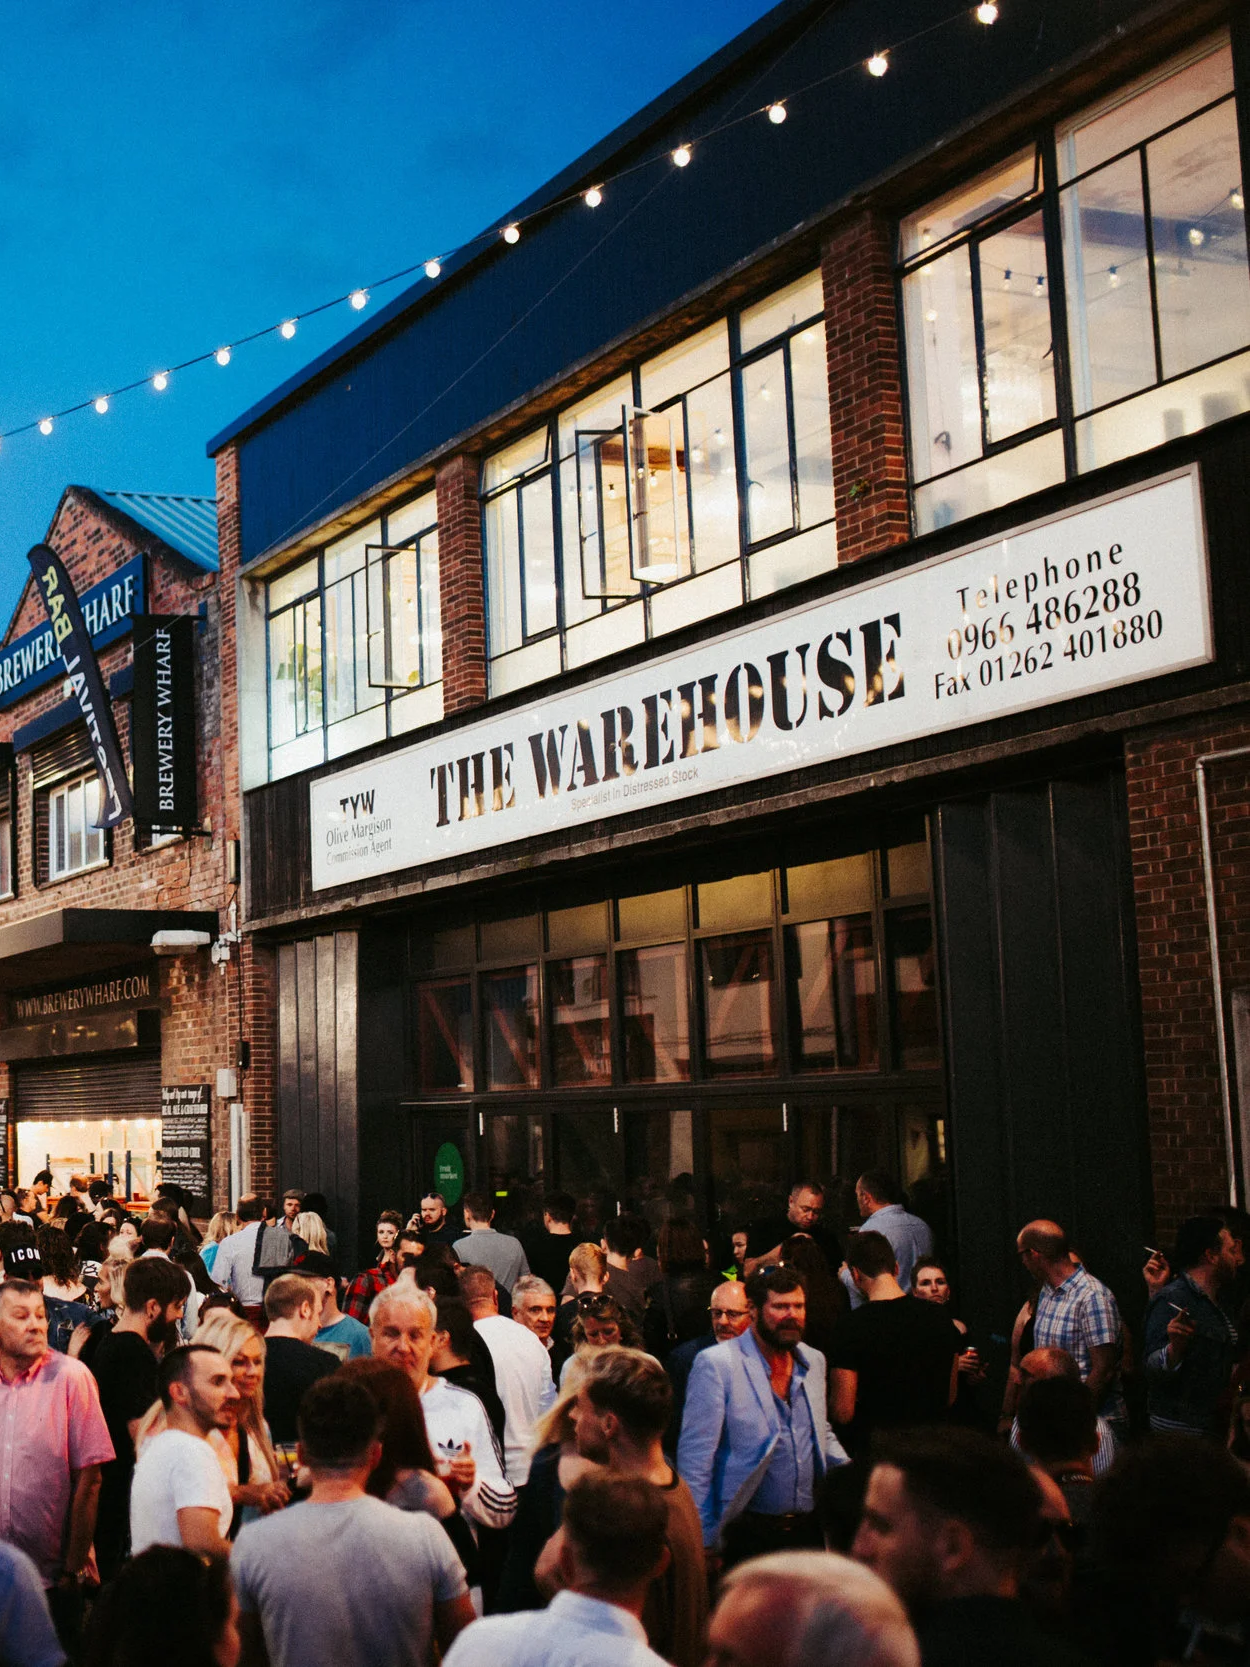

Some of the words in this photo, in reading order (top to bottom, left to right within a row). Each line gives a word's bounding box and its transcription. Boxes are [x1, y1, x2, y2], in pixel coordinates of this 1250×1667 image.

[81, 574, 133, 638] HARF
[956, 543, 1123, 614] Telephone
[947, 612, 1015, 661] 0966
[1026, 571, 1141, 636] 486288
[156, 628, 172, 707] WHARF
[934, 671, 971, 700] Fax
[979, 641, 1053, 687] 01262
[1063, 609, 1163, 662] 401880
[430, 742, 516, 828] THE
[528, 612, 906, 800] WAREHOUSE
[158, 712, 175, 811] BREWERY
[622, 774, 670, 798] Distressed
[671, 767, 700, 785] Stock
[326, 827, 349, 847] Olive
[351, 816, 392, 841] Margison
[339, 789, 375, 823] TYW
[370, 837, 392, 857] Agent
[16, 975, 150, 1018] WWW.BREWERYWHARF.COM
[11, 1247, 41, 1263] ICON
